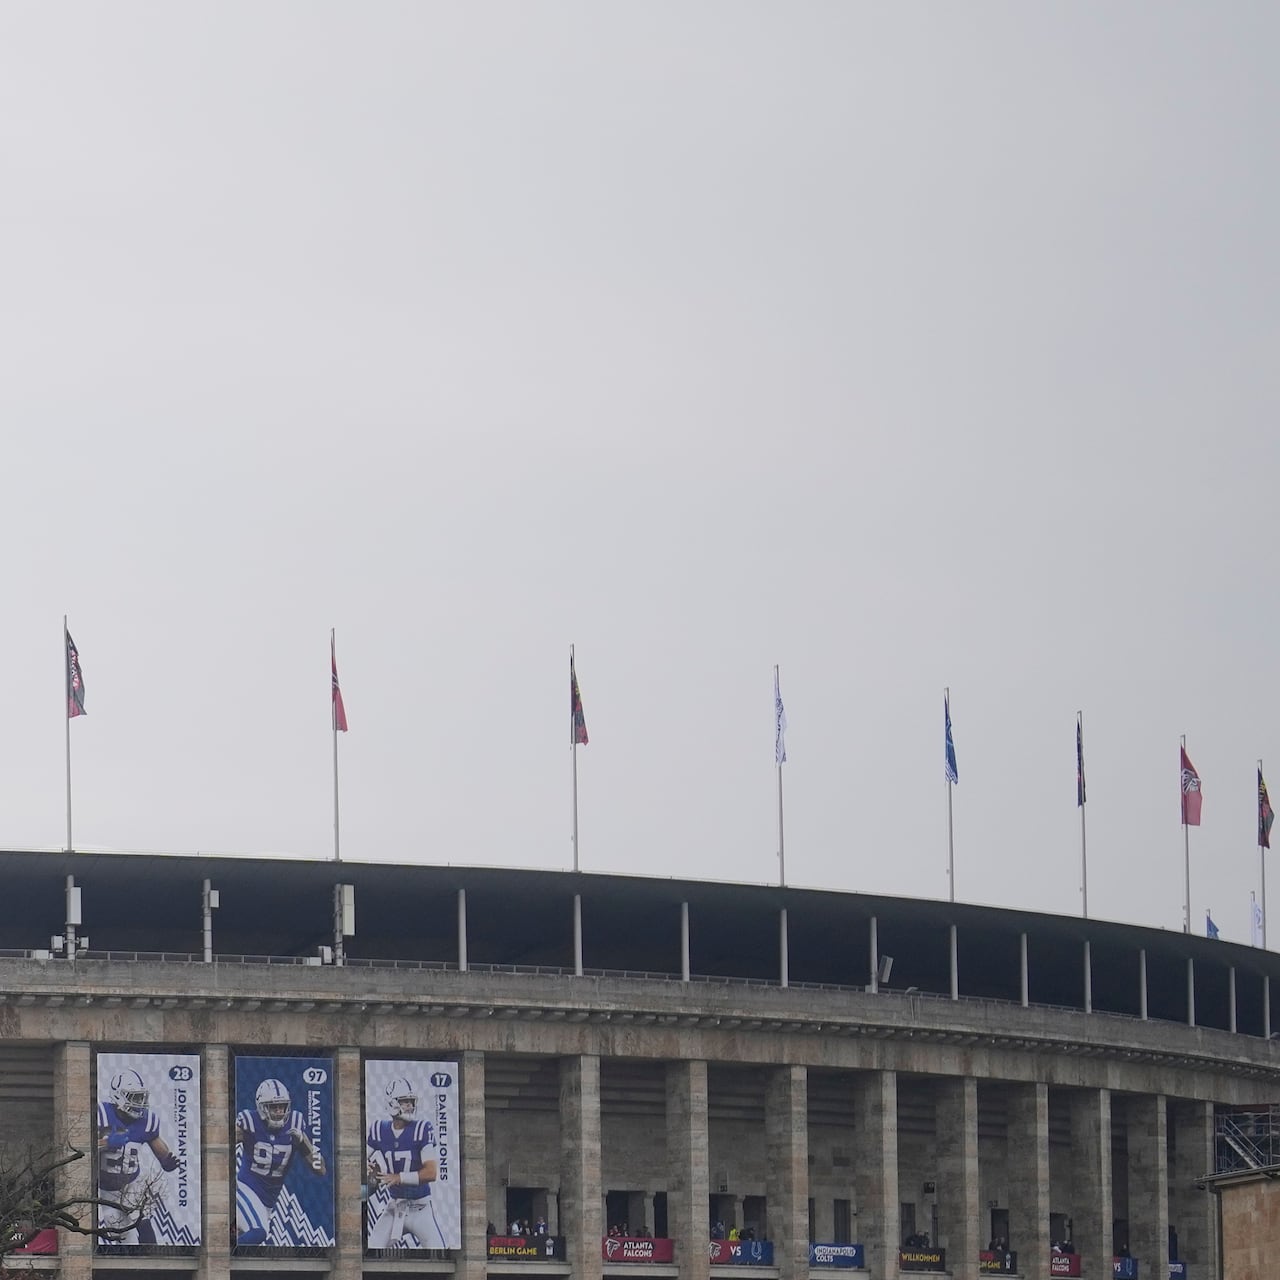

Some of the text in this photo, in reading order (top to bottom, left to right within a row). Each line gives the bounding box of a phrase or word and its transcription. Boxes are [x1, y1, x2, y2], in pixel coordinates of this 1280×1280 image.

[173, 1067, 189, 1080] 28
[308, 1070, 323, 1082] 97
[434, 1074, 448, 1086] 17
[310, 1090, 322, 1170] LAIATU LATU
[438, 1094, 448, 1181] DANIEL JONES
[177, 1088, 188, 1208] JONATHAN TAYLOR
[489, 1247, 537, 1255] BERLIN GAME
[623, 1241, 653, 1250] ATLANTA
[730, 1245, 742, 1256] VS
[623, 1249, 653, 1258] FALCONS
[815, 1255, 834, 1263] COLTS
[902, 1253, 940, 1263] WILLKOMMEN
[1113, 1262, 1121, 1272] VS
